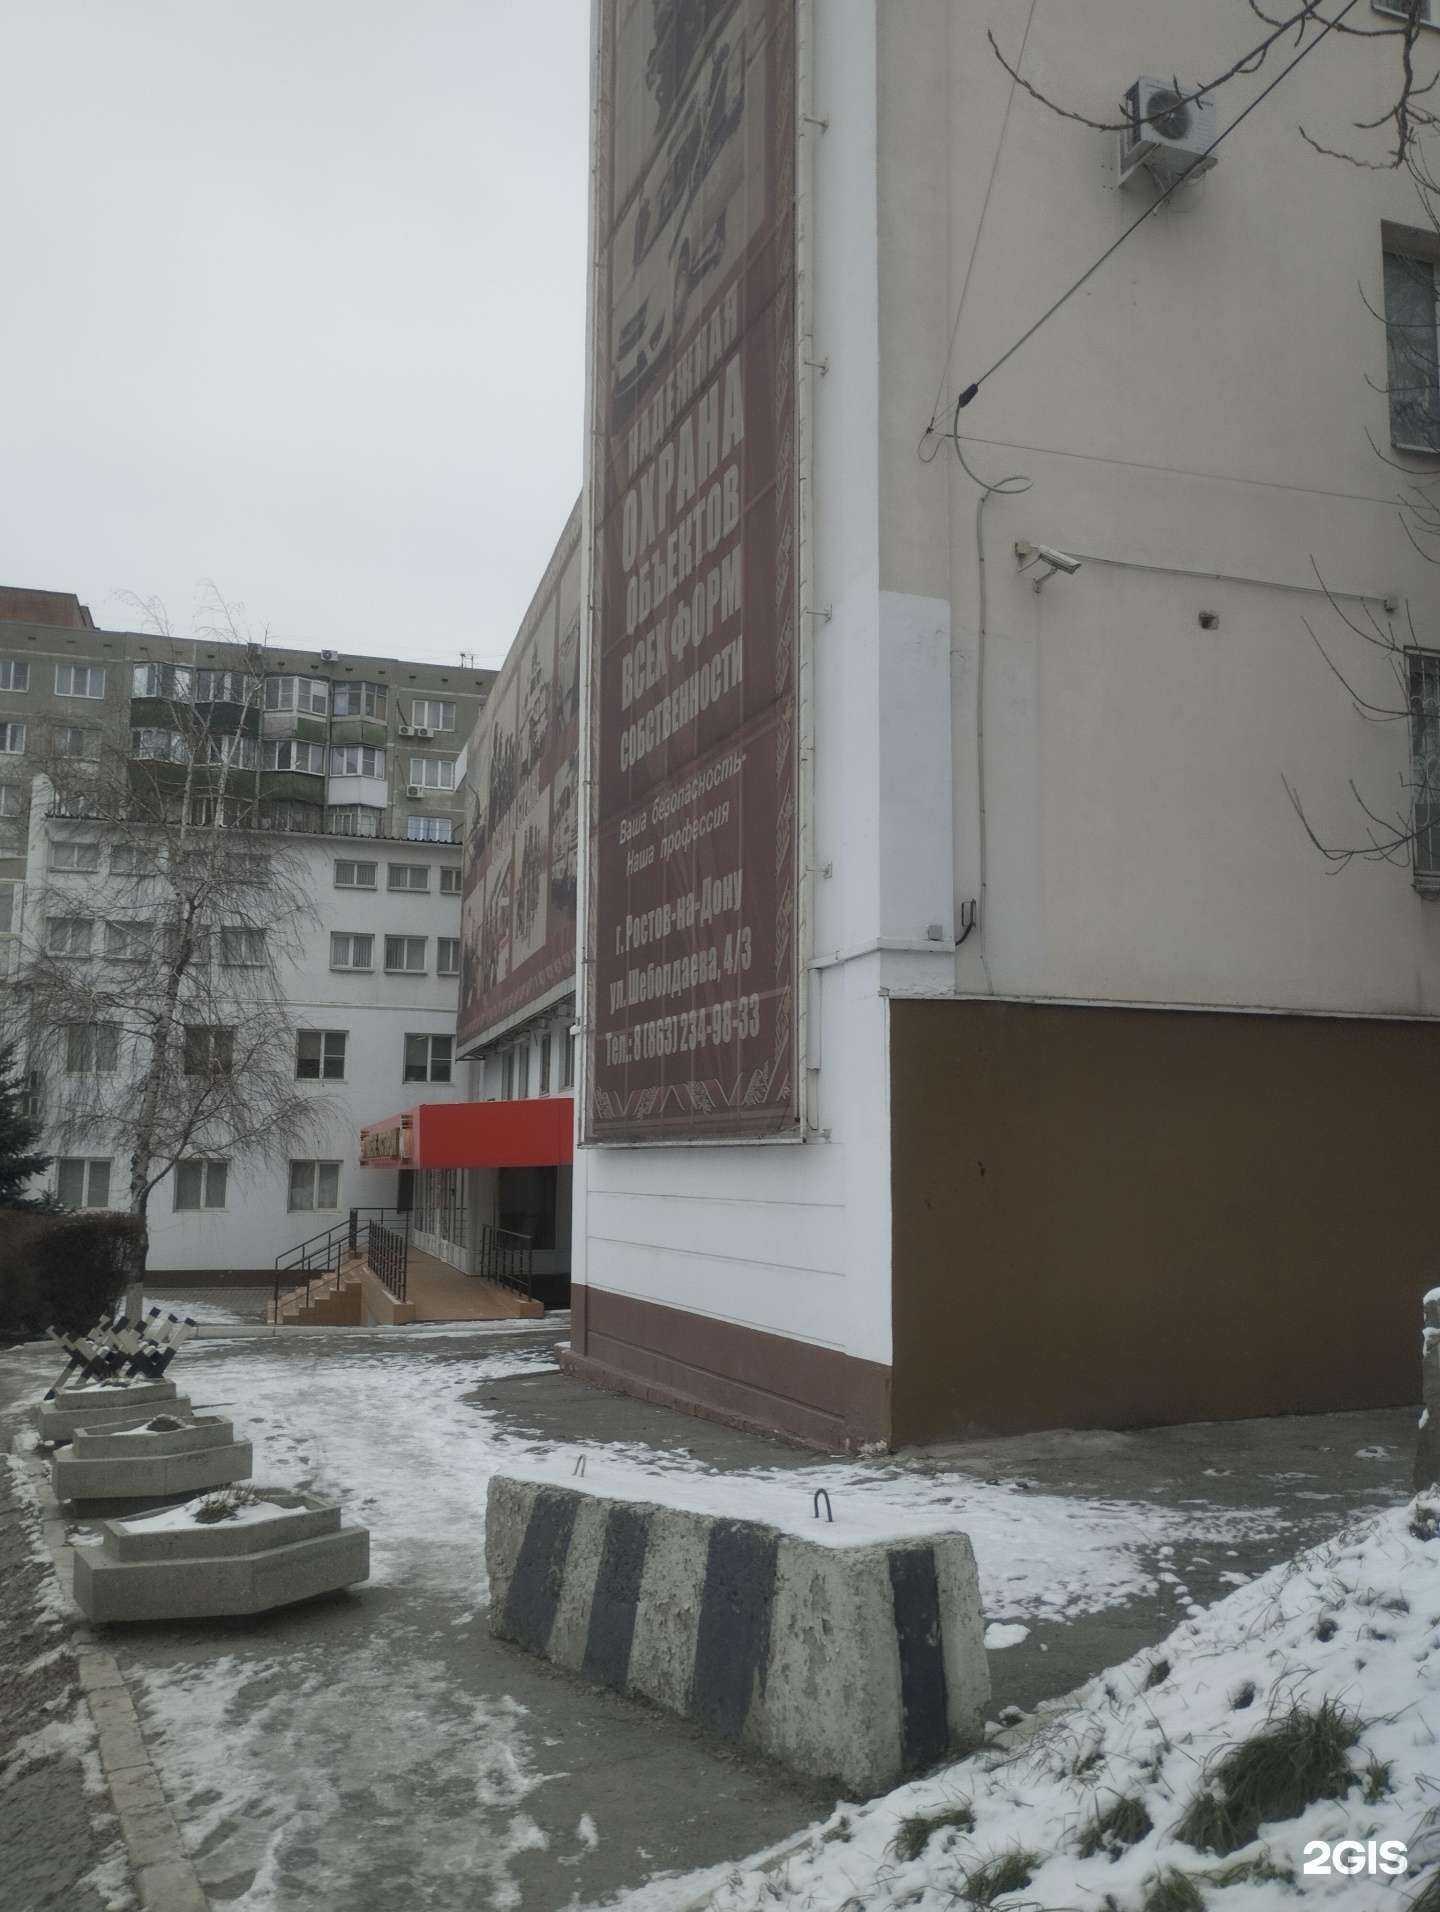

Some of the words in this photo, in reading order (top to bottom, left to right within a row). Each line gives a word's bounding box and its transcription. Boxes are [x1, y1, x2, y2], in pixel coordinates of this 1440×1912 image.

[622, 353, 745, 573] ОХРАНА
[626, 464, 740, 636] ОБЪЕКТОВ
[621, 618, 667, 712] ВСЕХ
[670, 543, 743, 662] ФОРМ
[619, 635, 744, 773] СОБСТВЕННОСТИ
[619, 810, 647, 844] Ваша
[626, 844, 655, 876] Наша
[660, 800, 730, 862] профессия
[723, 926, 752, 974] 4/3
